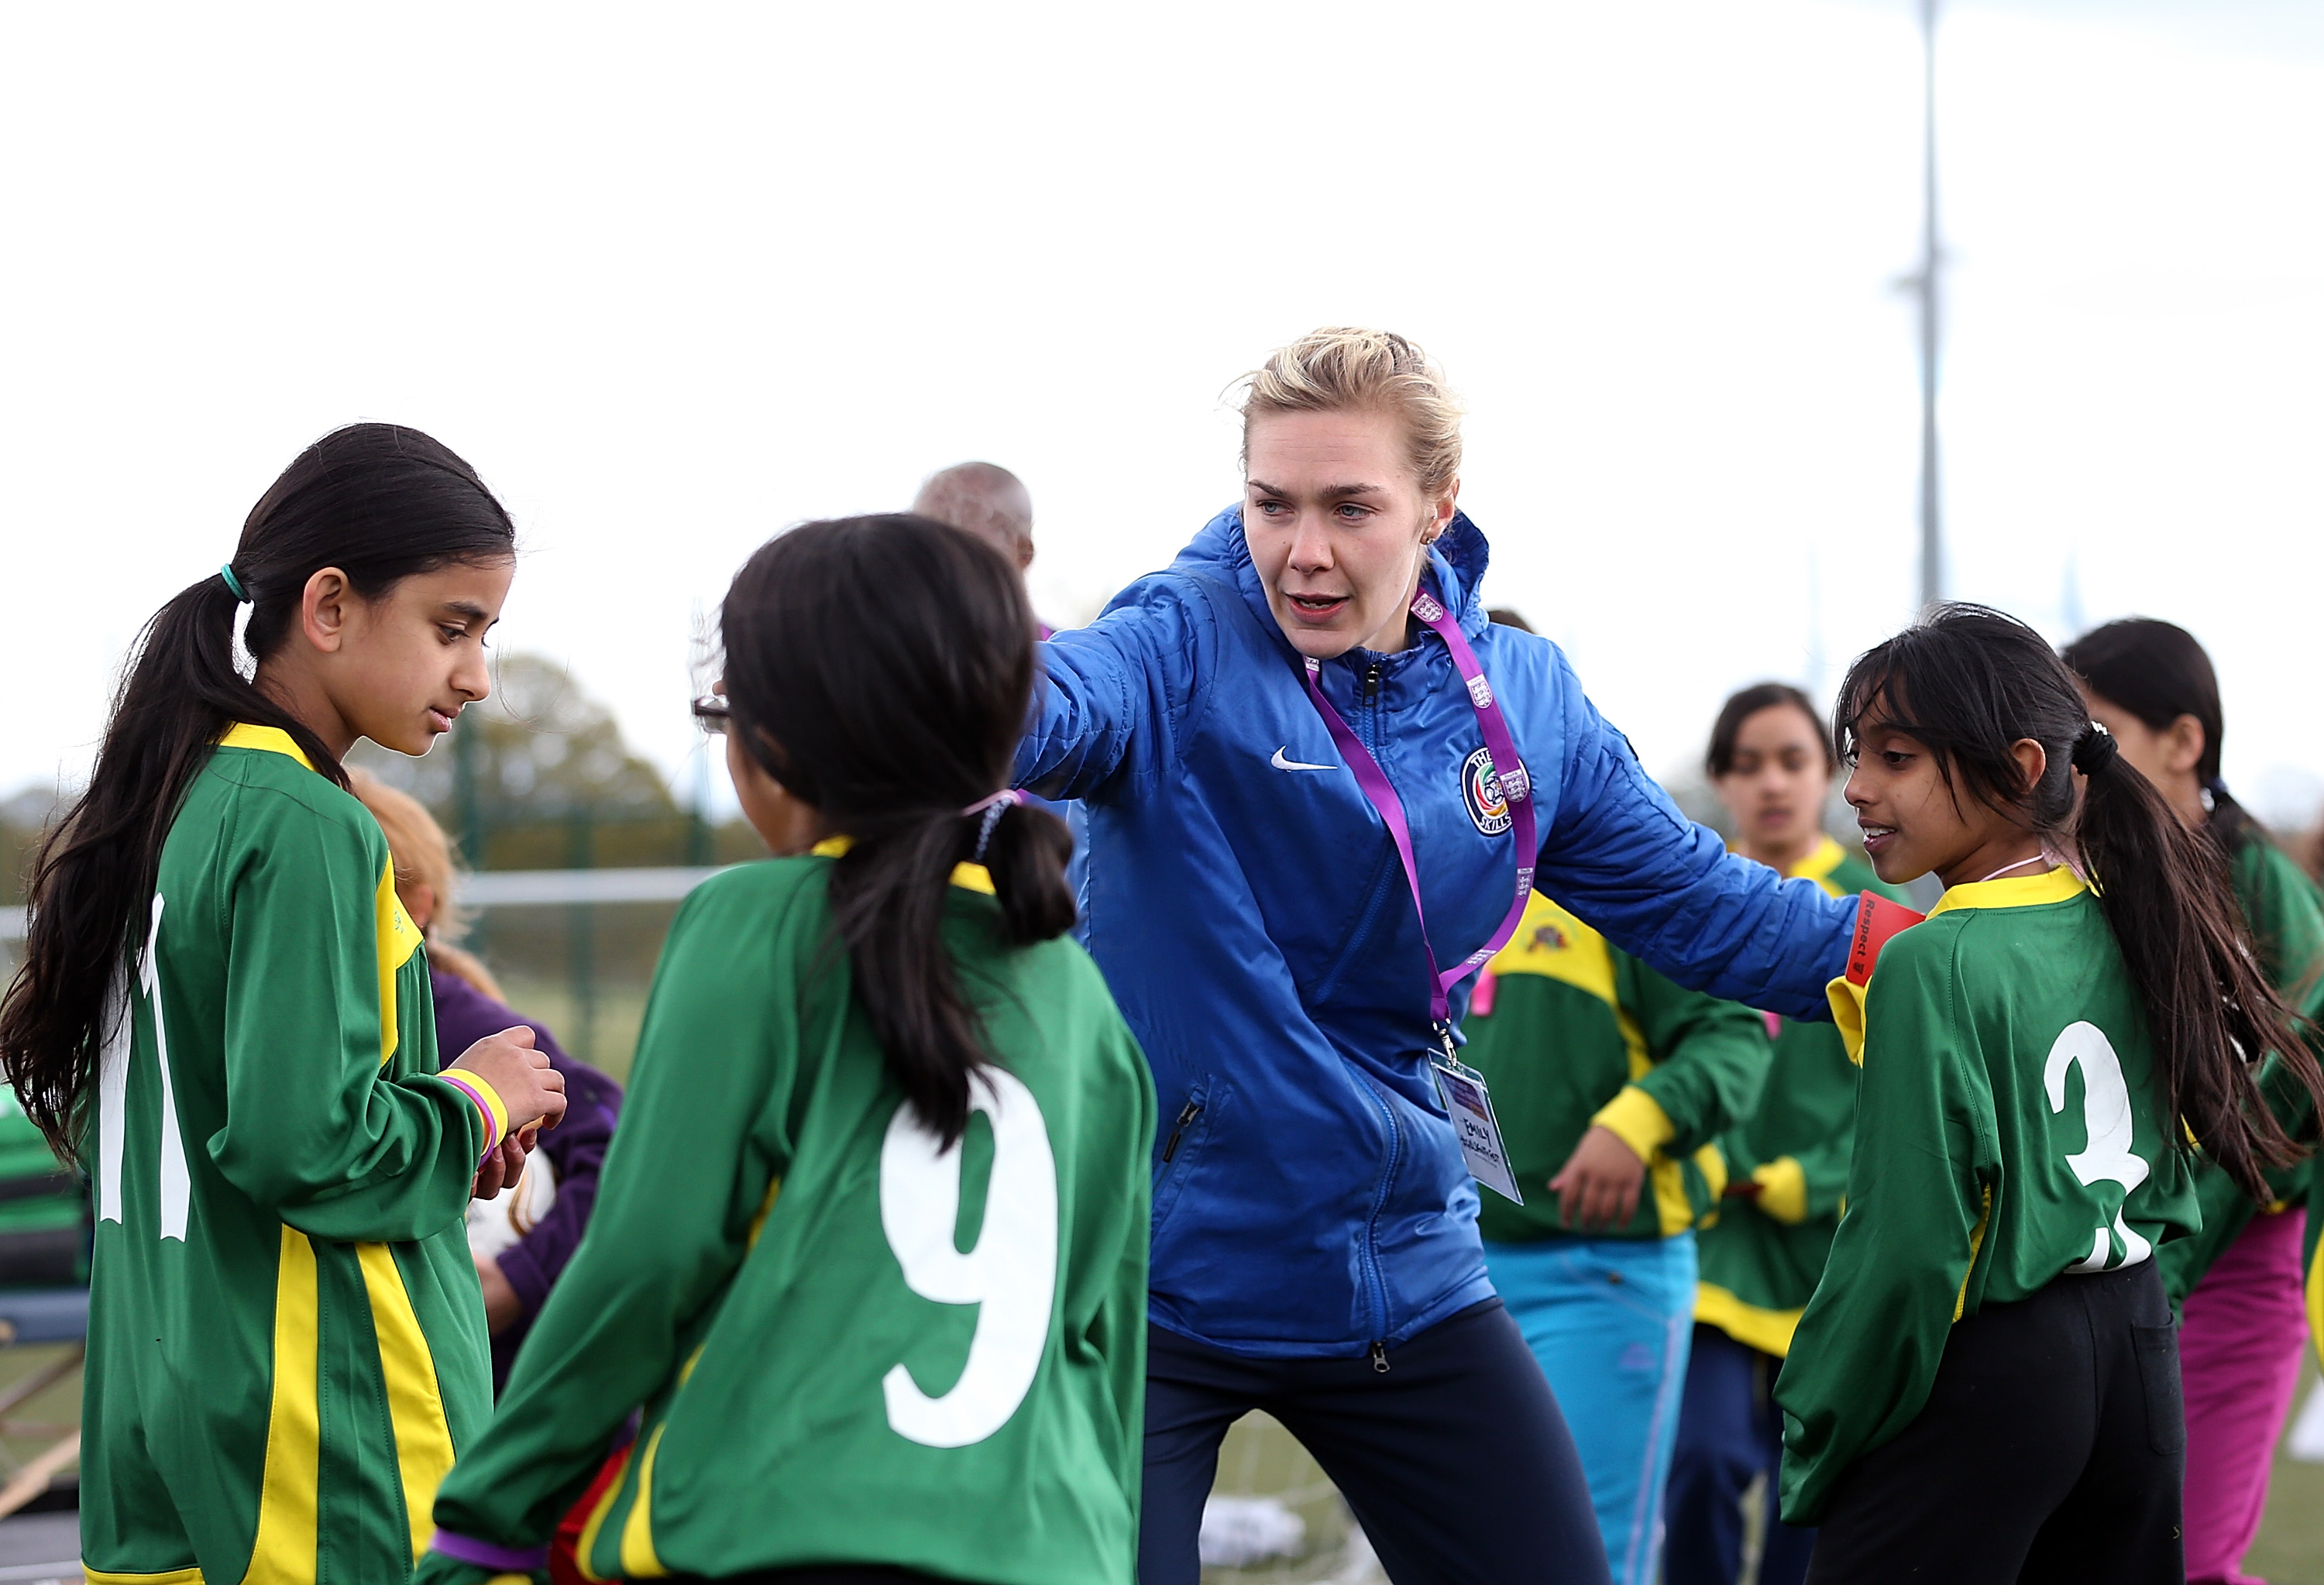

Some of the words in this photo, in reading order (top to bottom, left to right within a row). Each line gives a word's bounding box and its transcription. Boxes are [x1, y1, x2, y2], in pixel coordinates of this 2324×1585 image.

[1470, 750, 1492, 768] THE
[1480, 813, 1512, 830] SKILLS
[1857, 899, 1875, 957] Respect
[99, 892, 191, 1243] 11
[1463, 1118, 1492, 1147] EMILY
[880, 1062, 1058, 1449] 9
